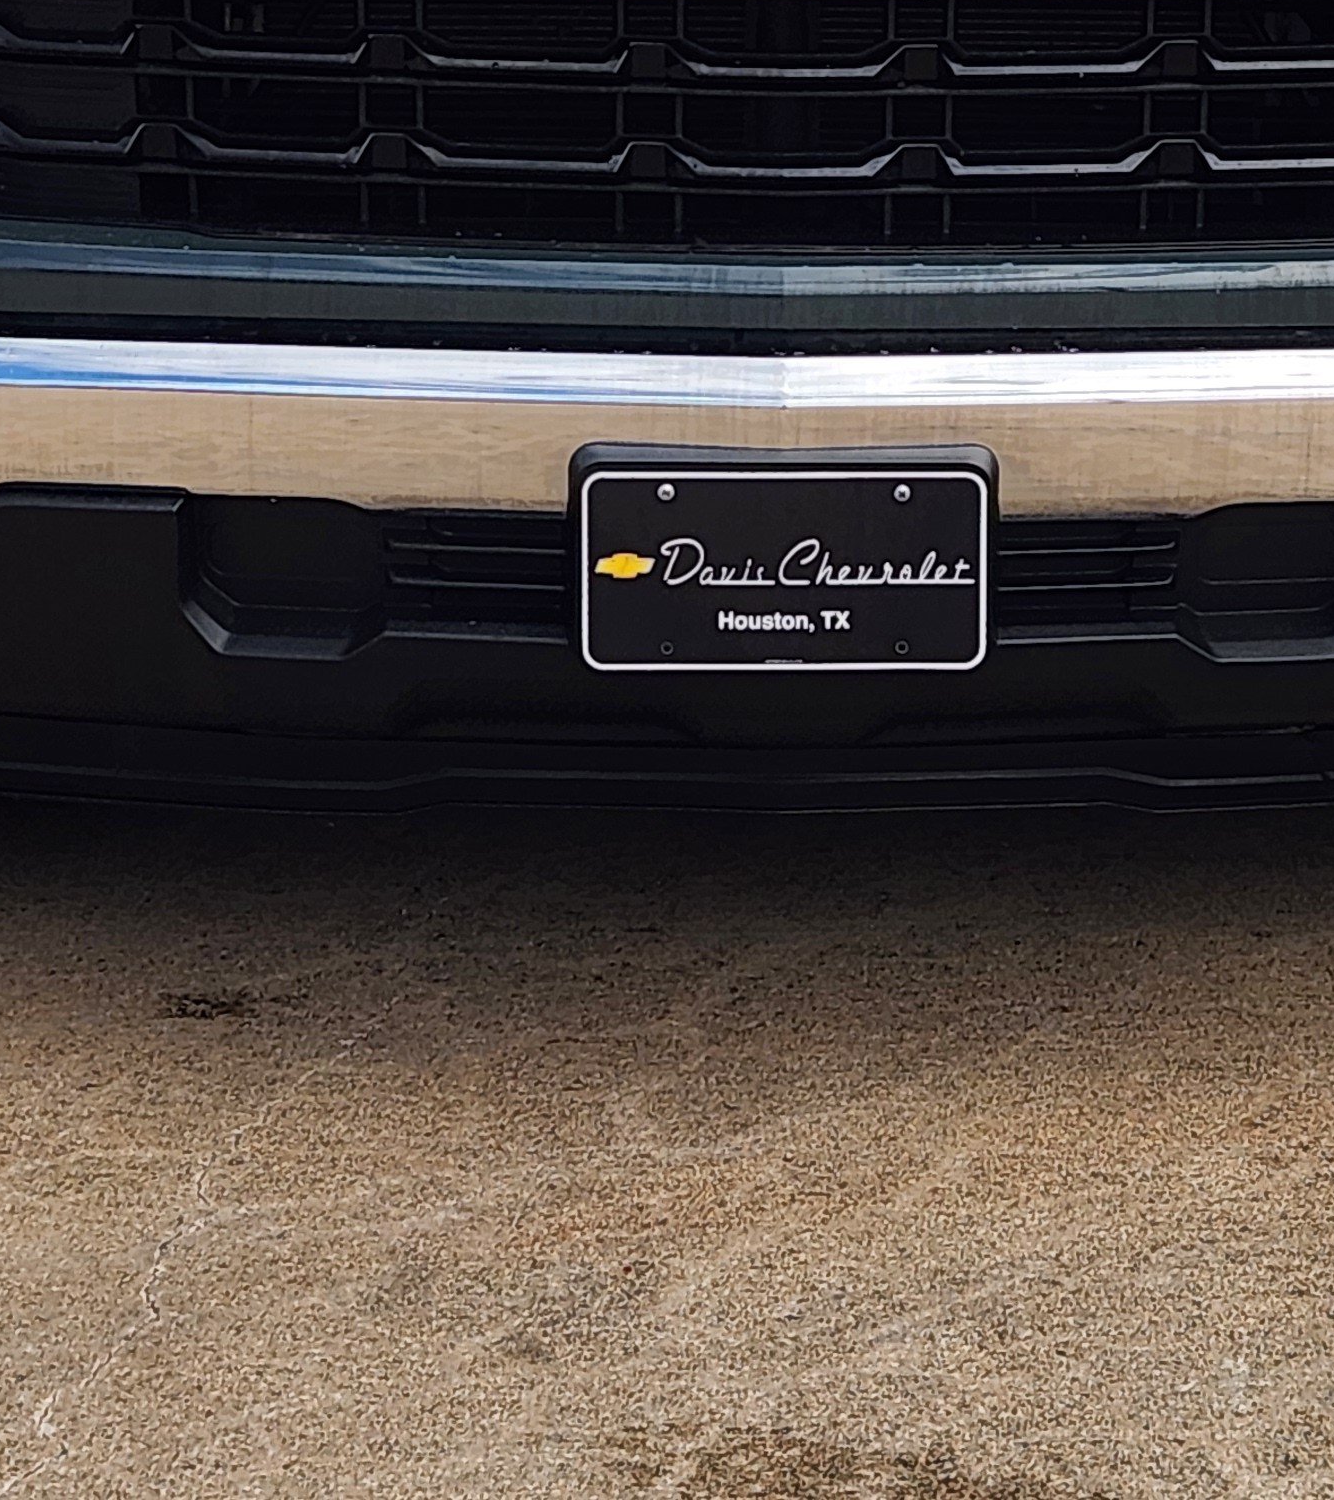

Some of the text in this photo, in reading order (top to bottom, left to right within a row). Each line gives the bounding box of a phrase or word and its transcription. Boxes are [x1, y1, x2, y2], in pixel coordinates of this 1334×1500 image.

[660, 538, 975, 586] Davis Chevrolet
[718, 610, 851, 633] Houston, TX
